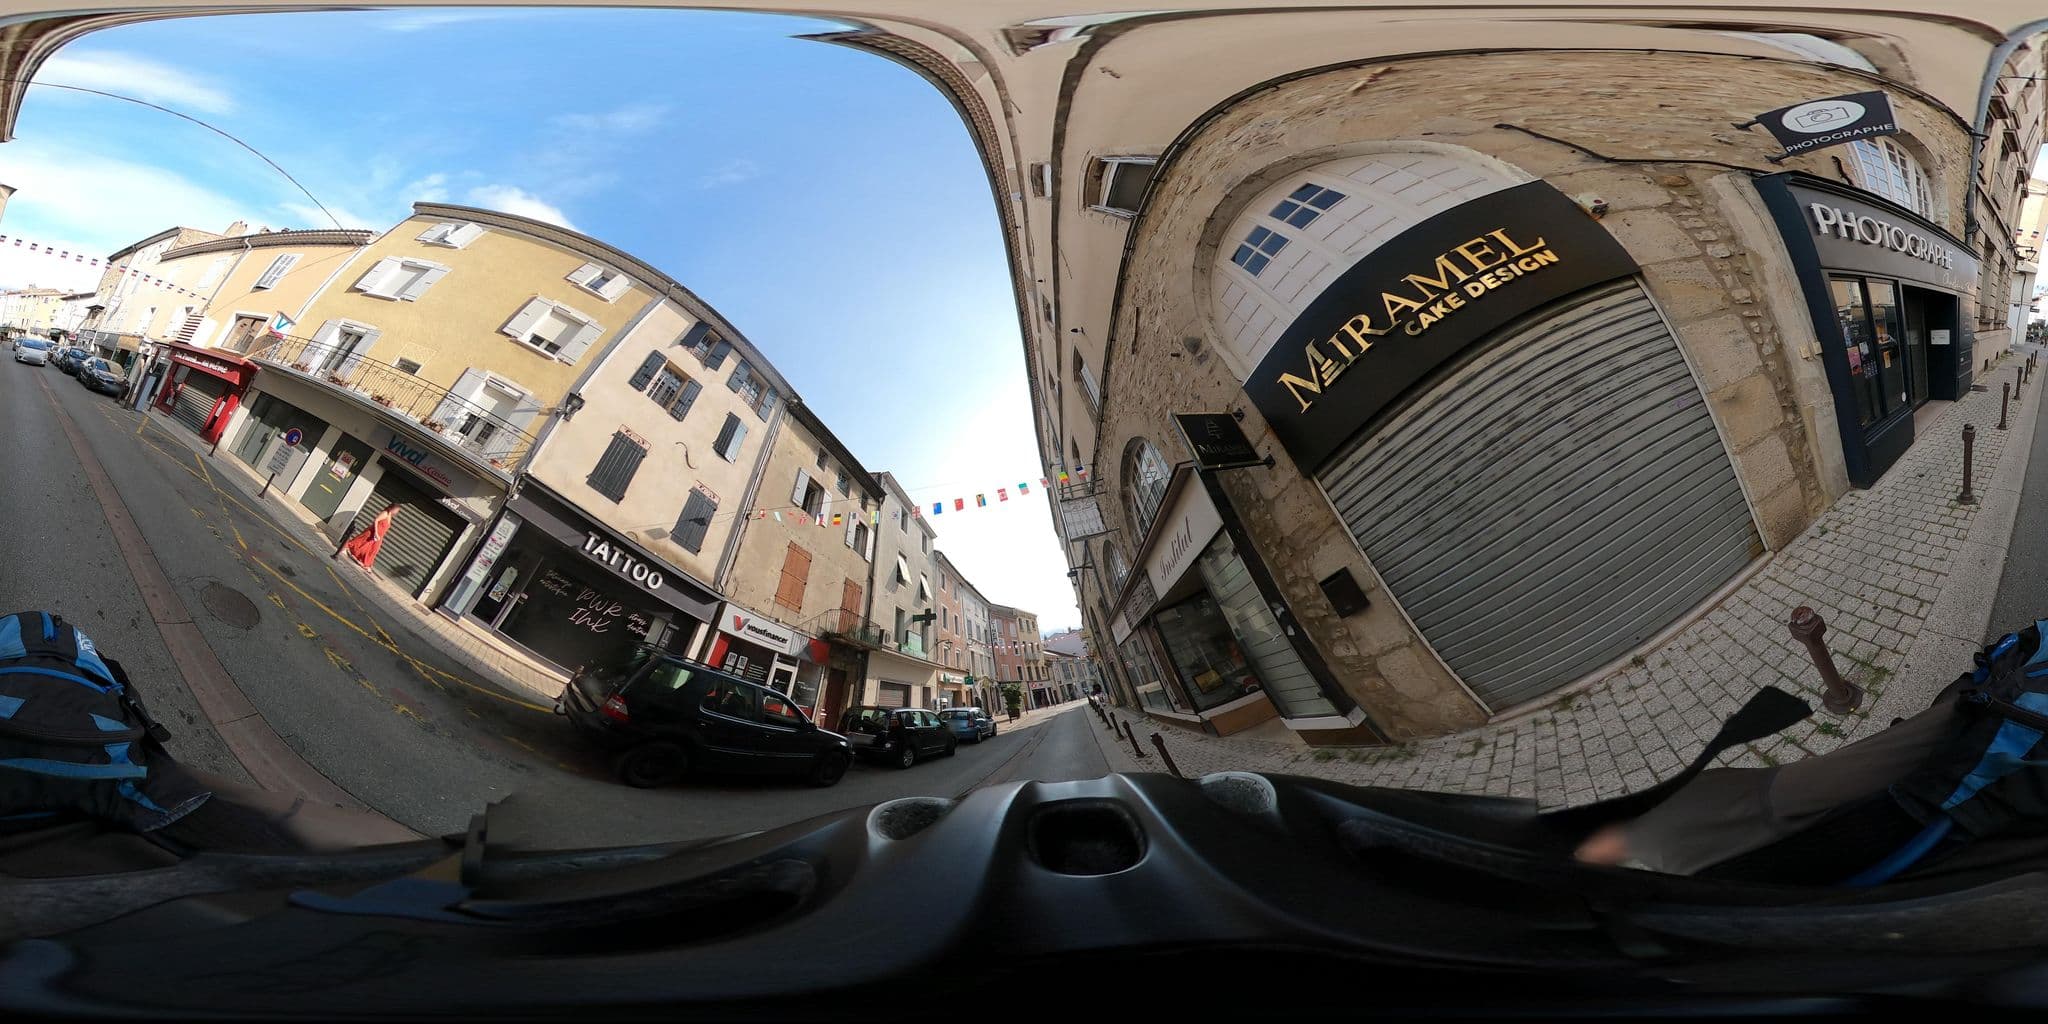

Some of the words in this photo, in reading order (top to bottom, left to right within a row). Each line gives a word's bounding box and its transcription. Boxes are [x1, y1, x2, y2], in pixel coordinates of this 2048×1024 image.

[1786, 122, 1894, 153] PHOTOGRAPHE
[1811, 202, 1953, 269] PHOTOGRAPHE
[1277, 228, 1546, 414] MIRAMEL
[1404, 291, 1466, 336] CAKE
[1463, 249, 1559, 299] DESIGN
[584, 530, 664, 590] TATTOO
[747, 623, 788, 645] vousfinancer
